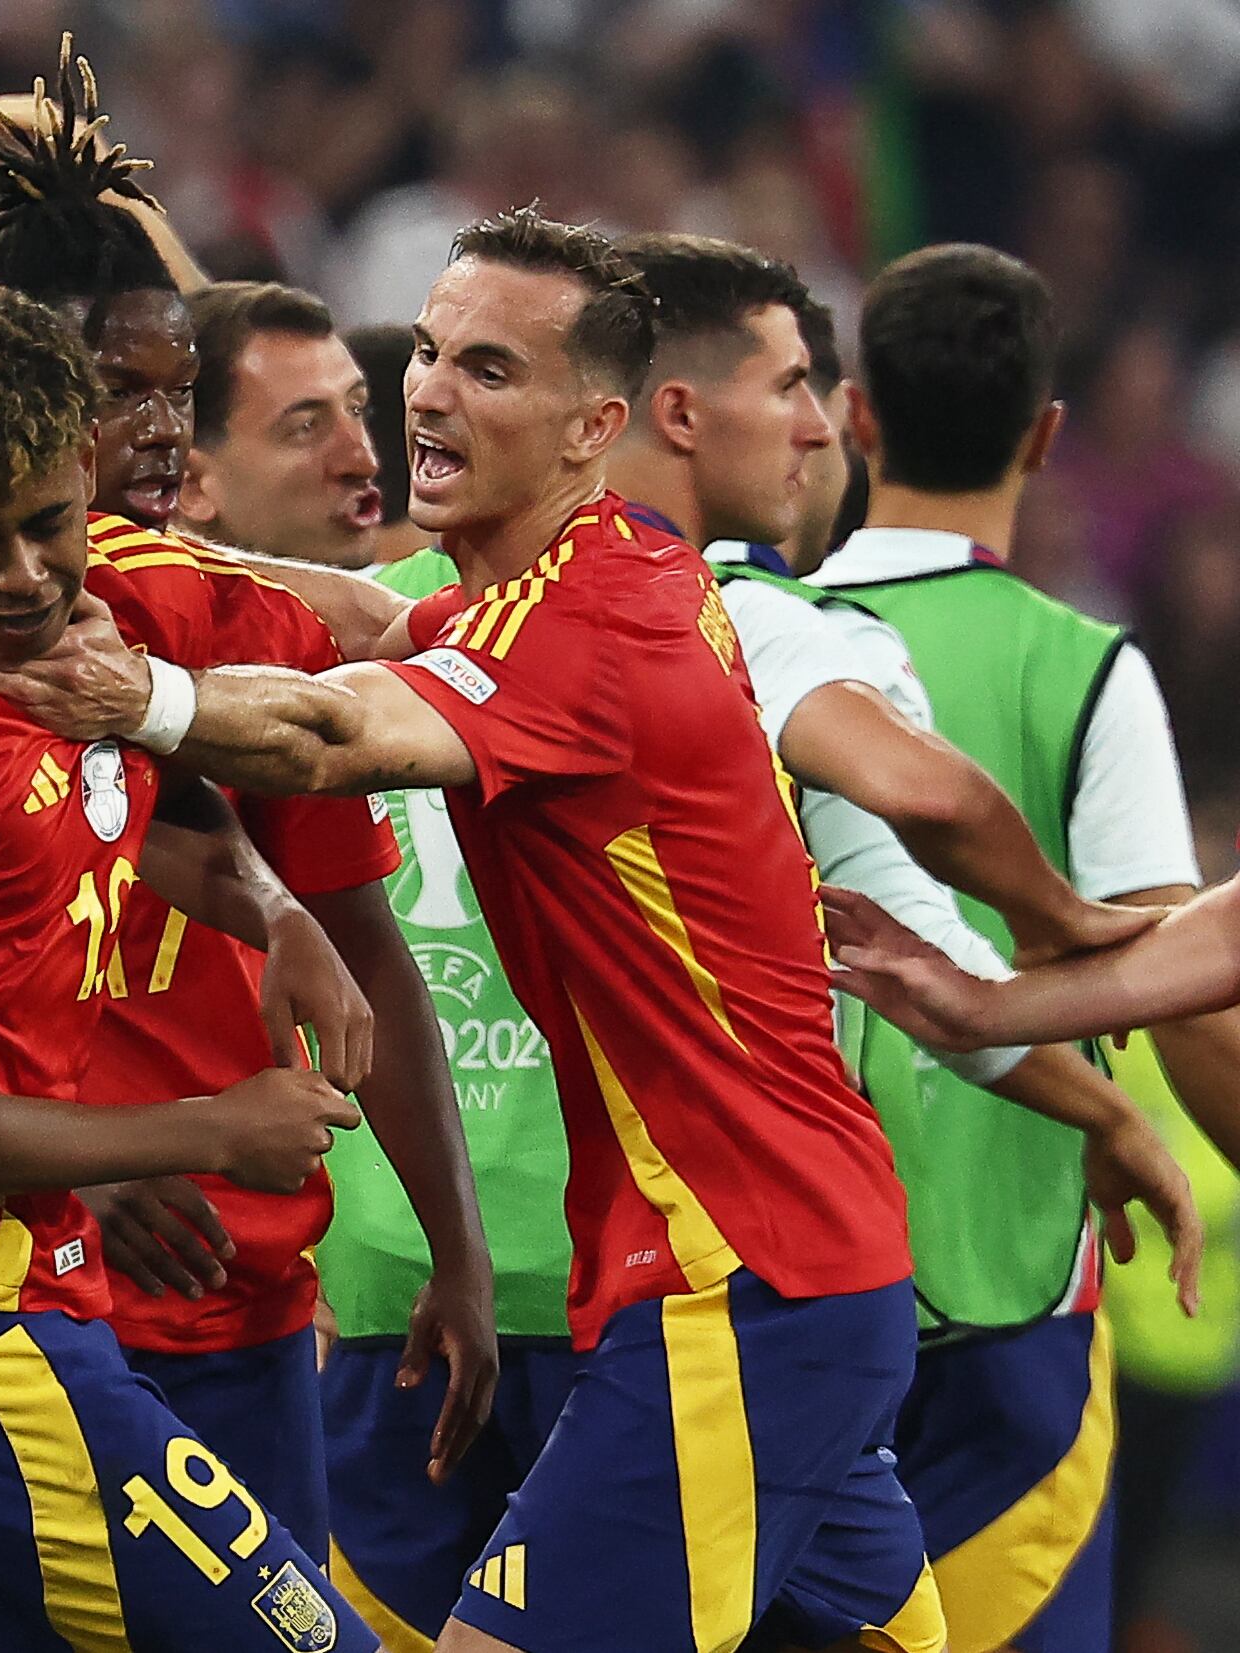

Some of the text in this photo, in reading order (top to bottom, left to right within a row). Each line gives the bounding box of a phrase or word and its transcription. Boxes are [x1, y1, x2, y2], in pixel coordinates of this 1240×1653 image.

[420, 953, 484, 1001] EFA
[438, 1018, 551, 1070] 202
[122, 1437, 269, 1586] 19
